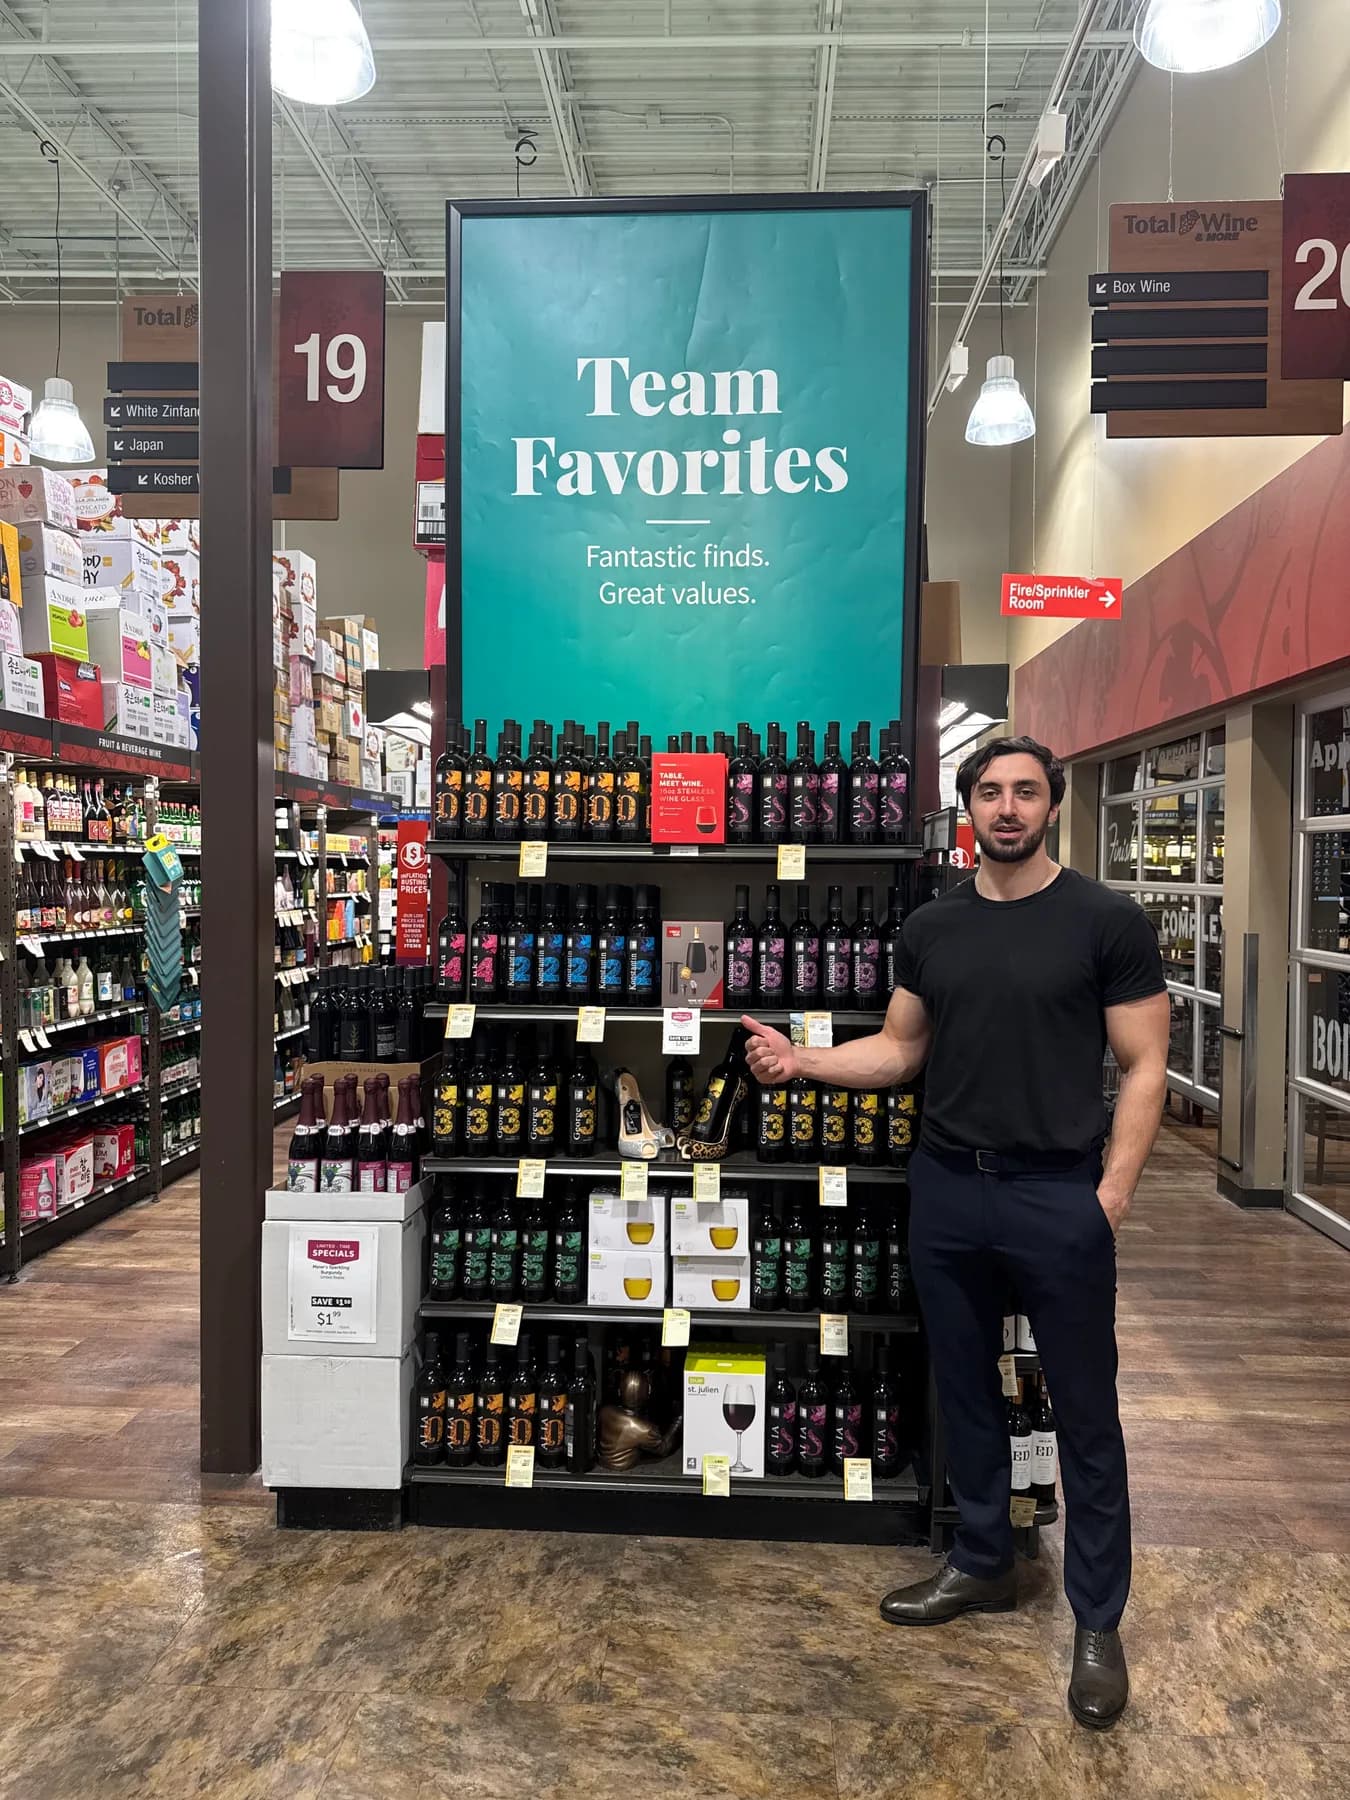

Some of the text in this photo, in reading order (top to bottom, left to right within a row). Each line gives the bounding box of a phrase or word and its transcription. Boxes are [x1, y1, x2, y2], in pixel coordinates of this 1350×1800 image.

[1124, 212, 1258, 234] Total Wine
[1204, 232, 1240, 242] MORE
[1113, 279, 1171, 294] Box Wine
[1294, 238, 1350, 312] 2
[133, 306, 182, 327] Total
[293, 333, 367, 403] 19
[577, 357, 782, 417] Team
[126, 403, 158, 418] White
[129, 438, 164, 454] Japan
[510, 429, 849, 497] Favorites
[153, 472, 193, 486] Kosher
[586, 543, 770, 567] Fantastic finds.
[598, 580, 757, 606] Great values.
[1009, 583, 1090, 600] Fire/Sprinkler
[1009, 597, 1044, 610] Room
[98, 737, 115, 747] FRUIT
[121, 742, 148, 757] BEVERAGE
[148, 748, 162, 758] WINE
[400, 886, 428, 894] PRICES
[513, 956, 531, 983] 2
[543, 956, 560, 983] 2
[571, 956, 588, 983] 2
[605, 958, 622, 986] 2
[634, 958, 652, 986] 2
[436, 1108, 453, 1135] 3
[470, 1108, 489, 1135] 3
[502, 1108, 520, 1135] 3
[536, 1109, 554, 1136] 3
[580, 1110, 595, 1136] 3
[695, 1098, 712, 1123] 3
[767, 1113, 784, 1141] 3
[794, 1114, 813, 1141] 3
[827, 1115, 845, 1144] 3
[857, 1116, 874, 1145] 3
[893, 1117, 911, 1146] 3
[312, 1250, 355, 1258] SPECIALS
[697, 1386, 719, 1394] julien
